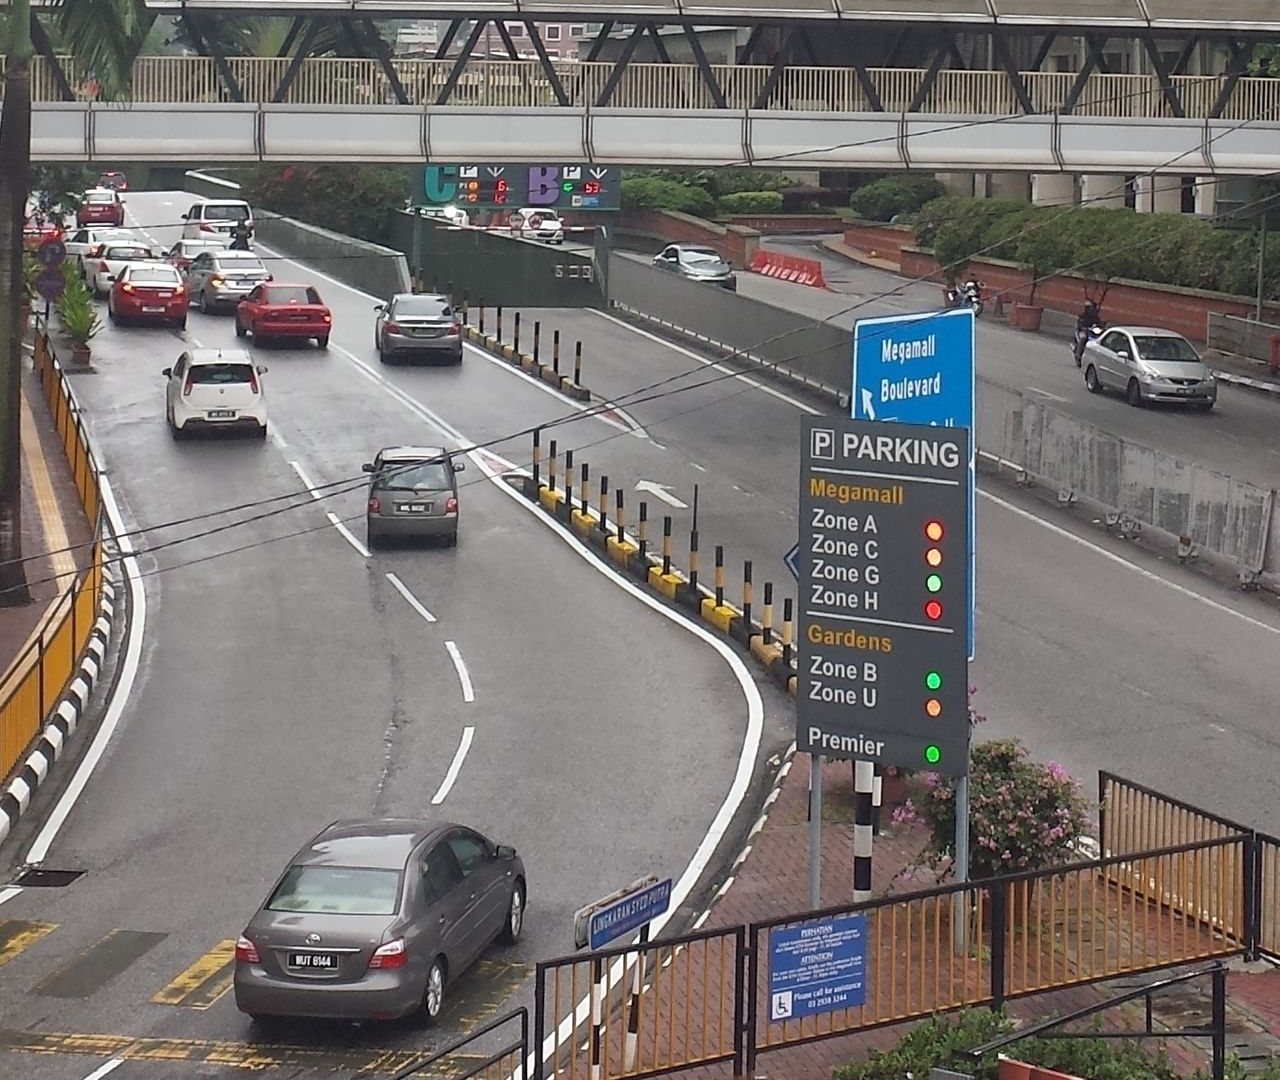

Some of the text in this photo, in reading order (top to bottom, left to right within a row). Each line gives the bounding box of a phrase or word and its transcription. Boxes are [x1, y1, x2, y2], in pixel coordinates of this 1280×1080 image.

[528, 167, 560, 205] B
[882, 333, 935, 365] Megamall
[881, 371, 941, 402] Boulevard
[843, 433, 959, 468] PARKING
[810, 478, 904, 505] Megamall
[811, 508, 878, 534] Zone A
[811, 534, 878, 559] Zone C
[811, 559, 880, 585] Zone G
[811, 585, 878, 610] Zone H
[808, 624, 893, 652] Gardens
[810, 656, 877, 682] Zone B
[809, 681, 877, 707] Zone U
[808, 727, 884, 756] Premier
[801, 951, 833, 966] ATTENTION
